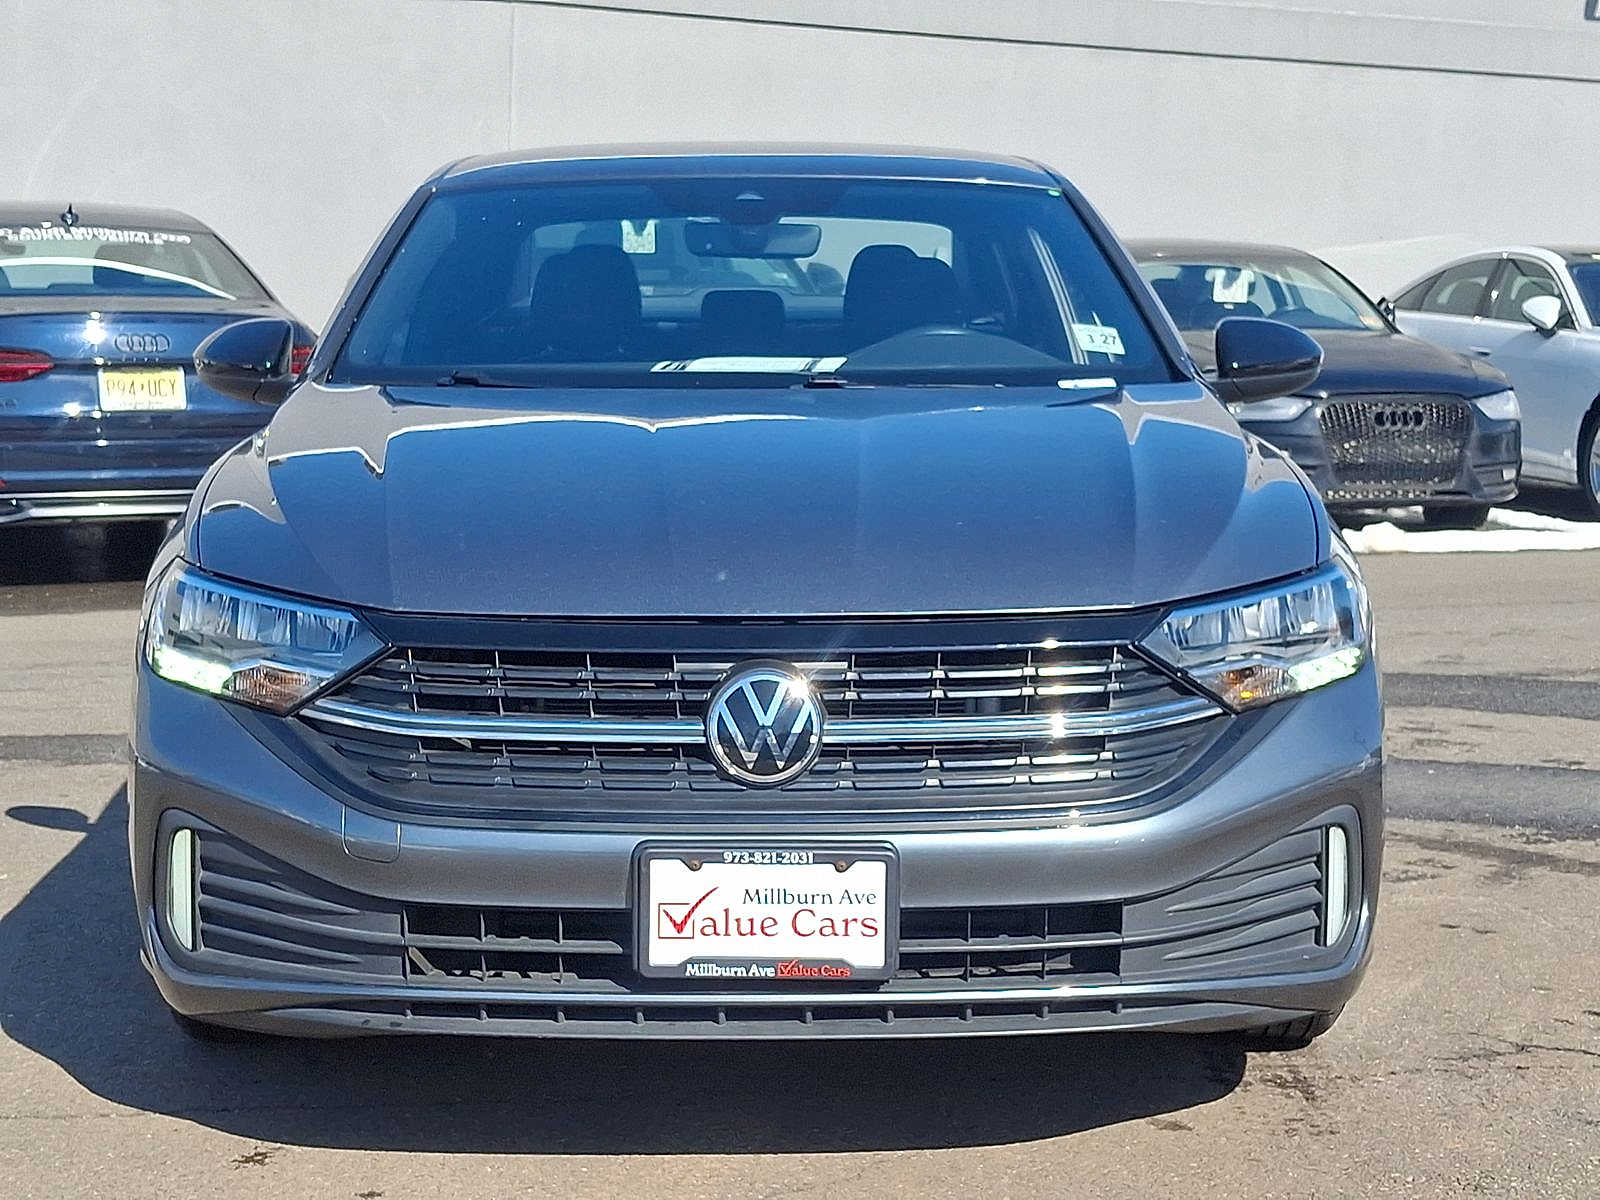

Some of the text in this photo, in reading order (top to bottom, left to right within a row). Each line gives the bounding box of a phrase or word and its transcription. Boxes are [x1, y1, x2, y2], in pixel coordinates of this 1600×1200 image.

[722, 851, 815, 865] 973-821-2031
[742, 888, 877, 905] Millburn Ave
[791, 908, 879, 938] Cars
[685, 963, 747, 977] Millburn
[749, 963, 775, 977] Ave
[821, 964, 851, 977] Cars
